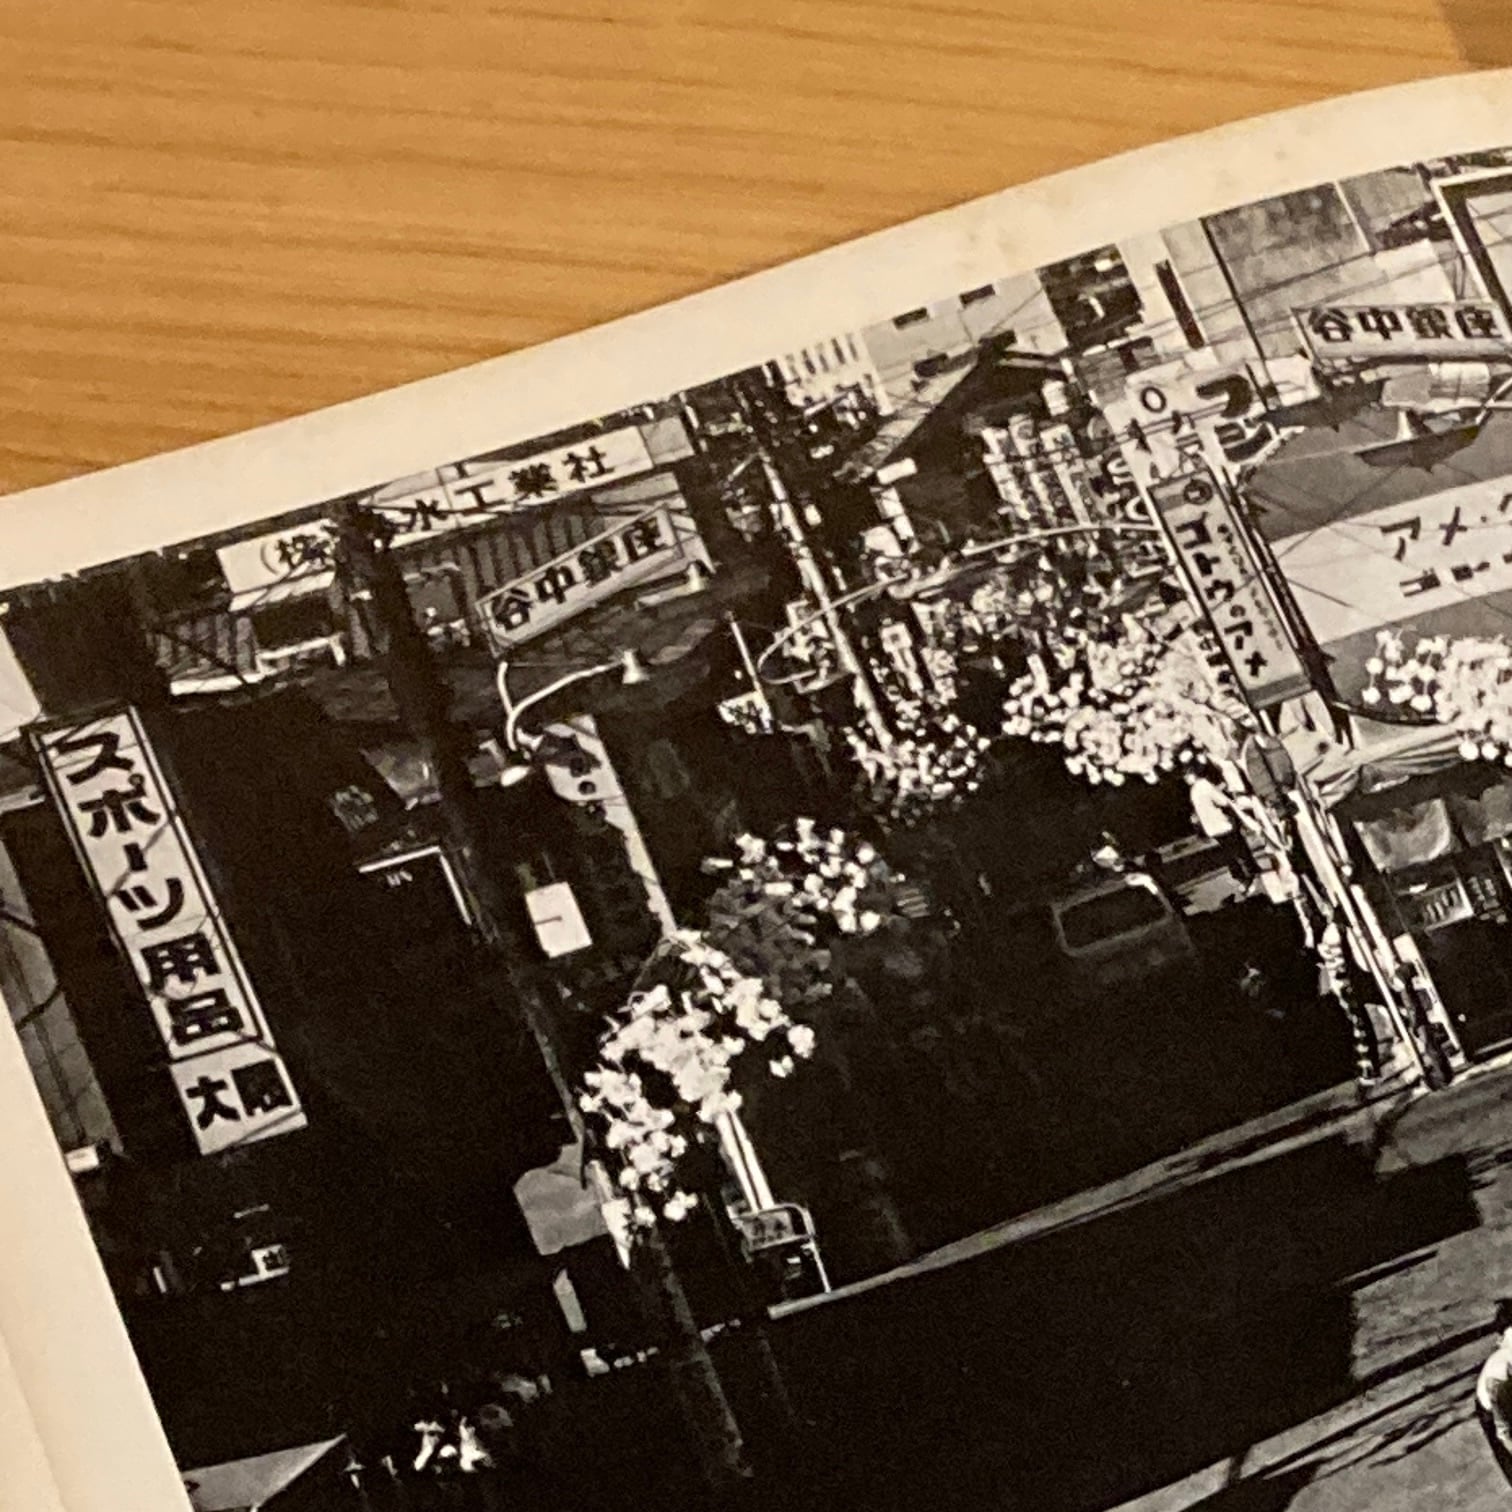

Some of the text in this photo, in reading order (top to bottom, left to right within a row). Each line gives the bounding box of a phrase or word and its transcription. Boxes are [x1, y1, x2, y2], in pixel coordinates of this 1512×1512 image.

[1308, 305, 1503, 343] 谷中銀座
[493, 516, 666, 632] 谷中銀座
[56, 730, 245, 1046] スポーツ用品
